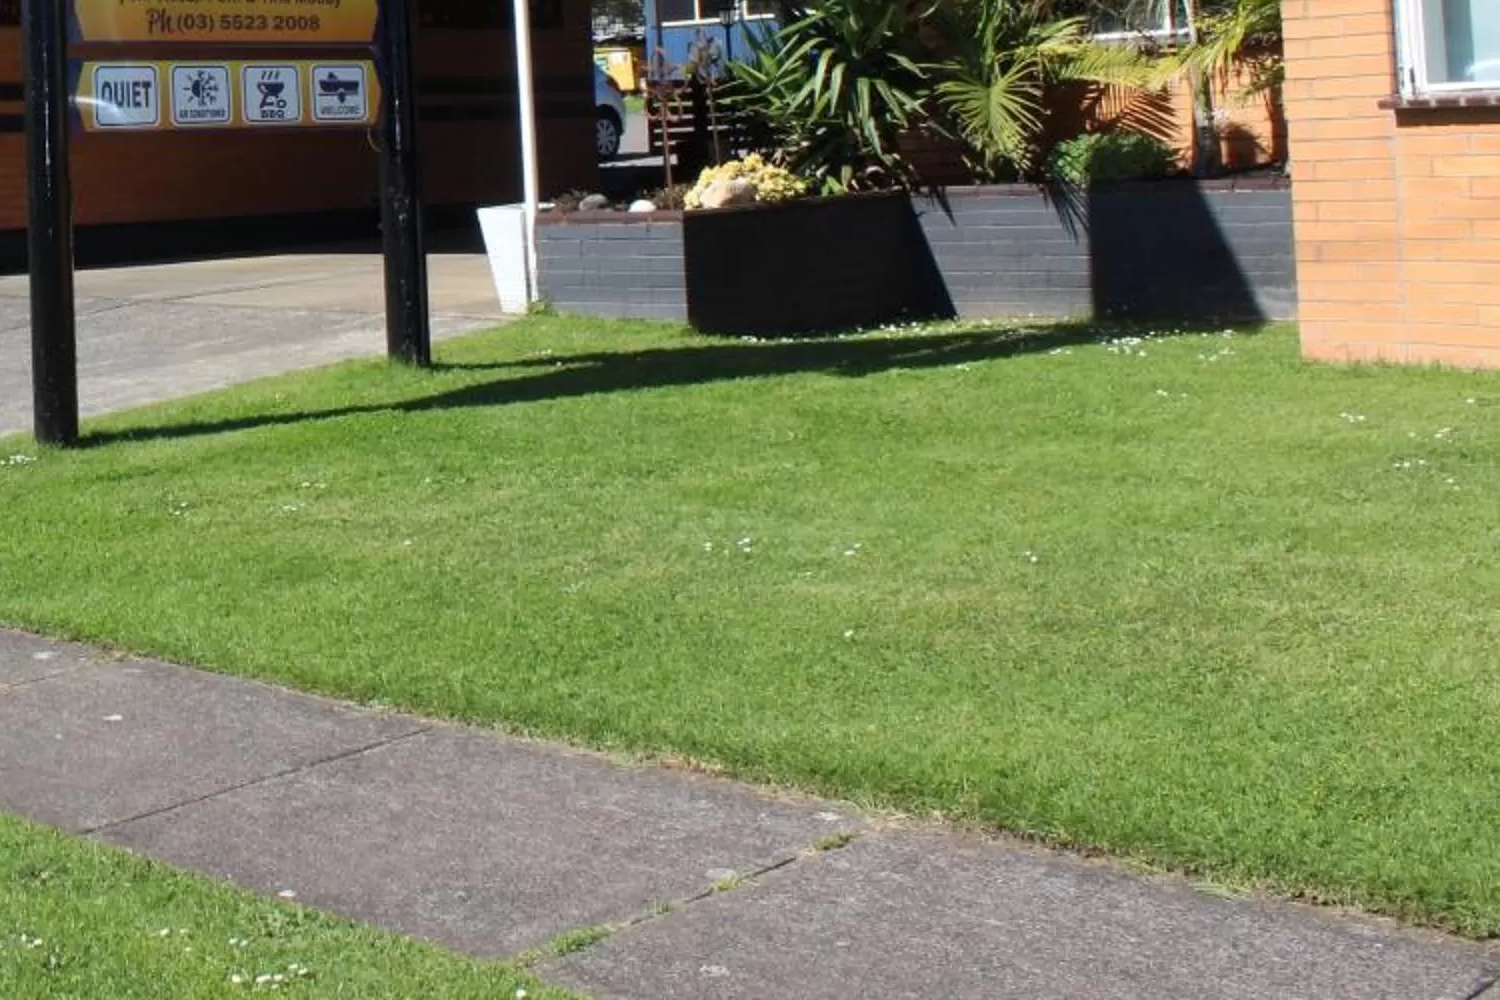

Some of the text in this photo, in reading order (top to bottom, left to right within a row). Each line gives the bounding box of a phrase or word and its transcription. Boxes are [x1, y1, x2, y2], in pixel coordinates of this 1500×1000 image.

[177, 12, 214, 34] (03)
[100, 80, 152, 109] QUIET
[260, 108, 286, 119] BBQ
